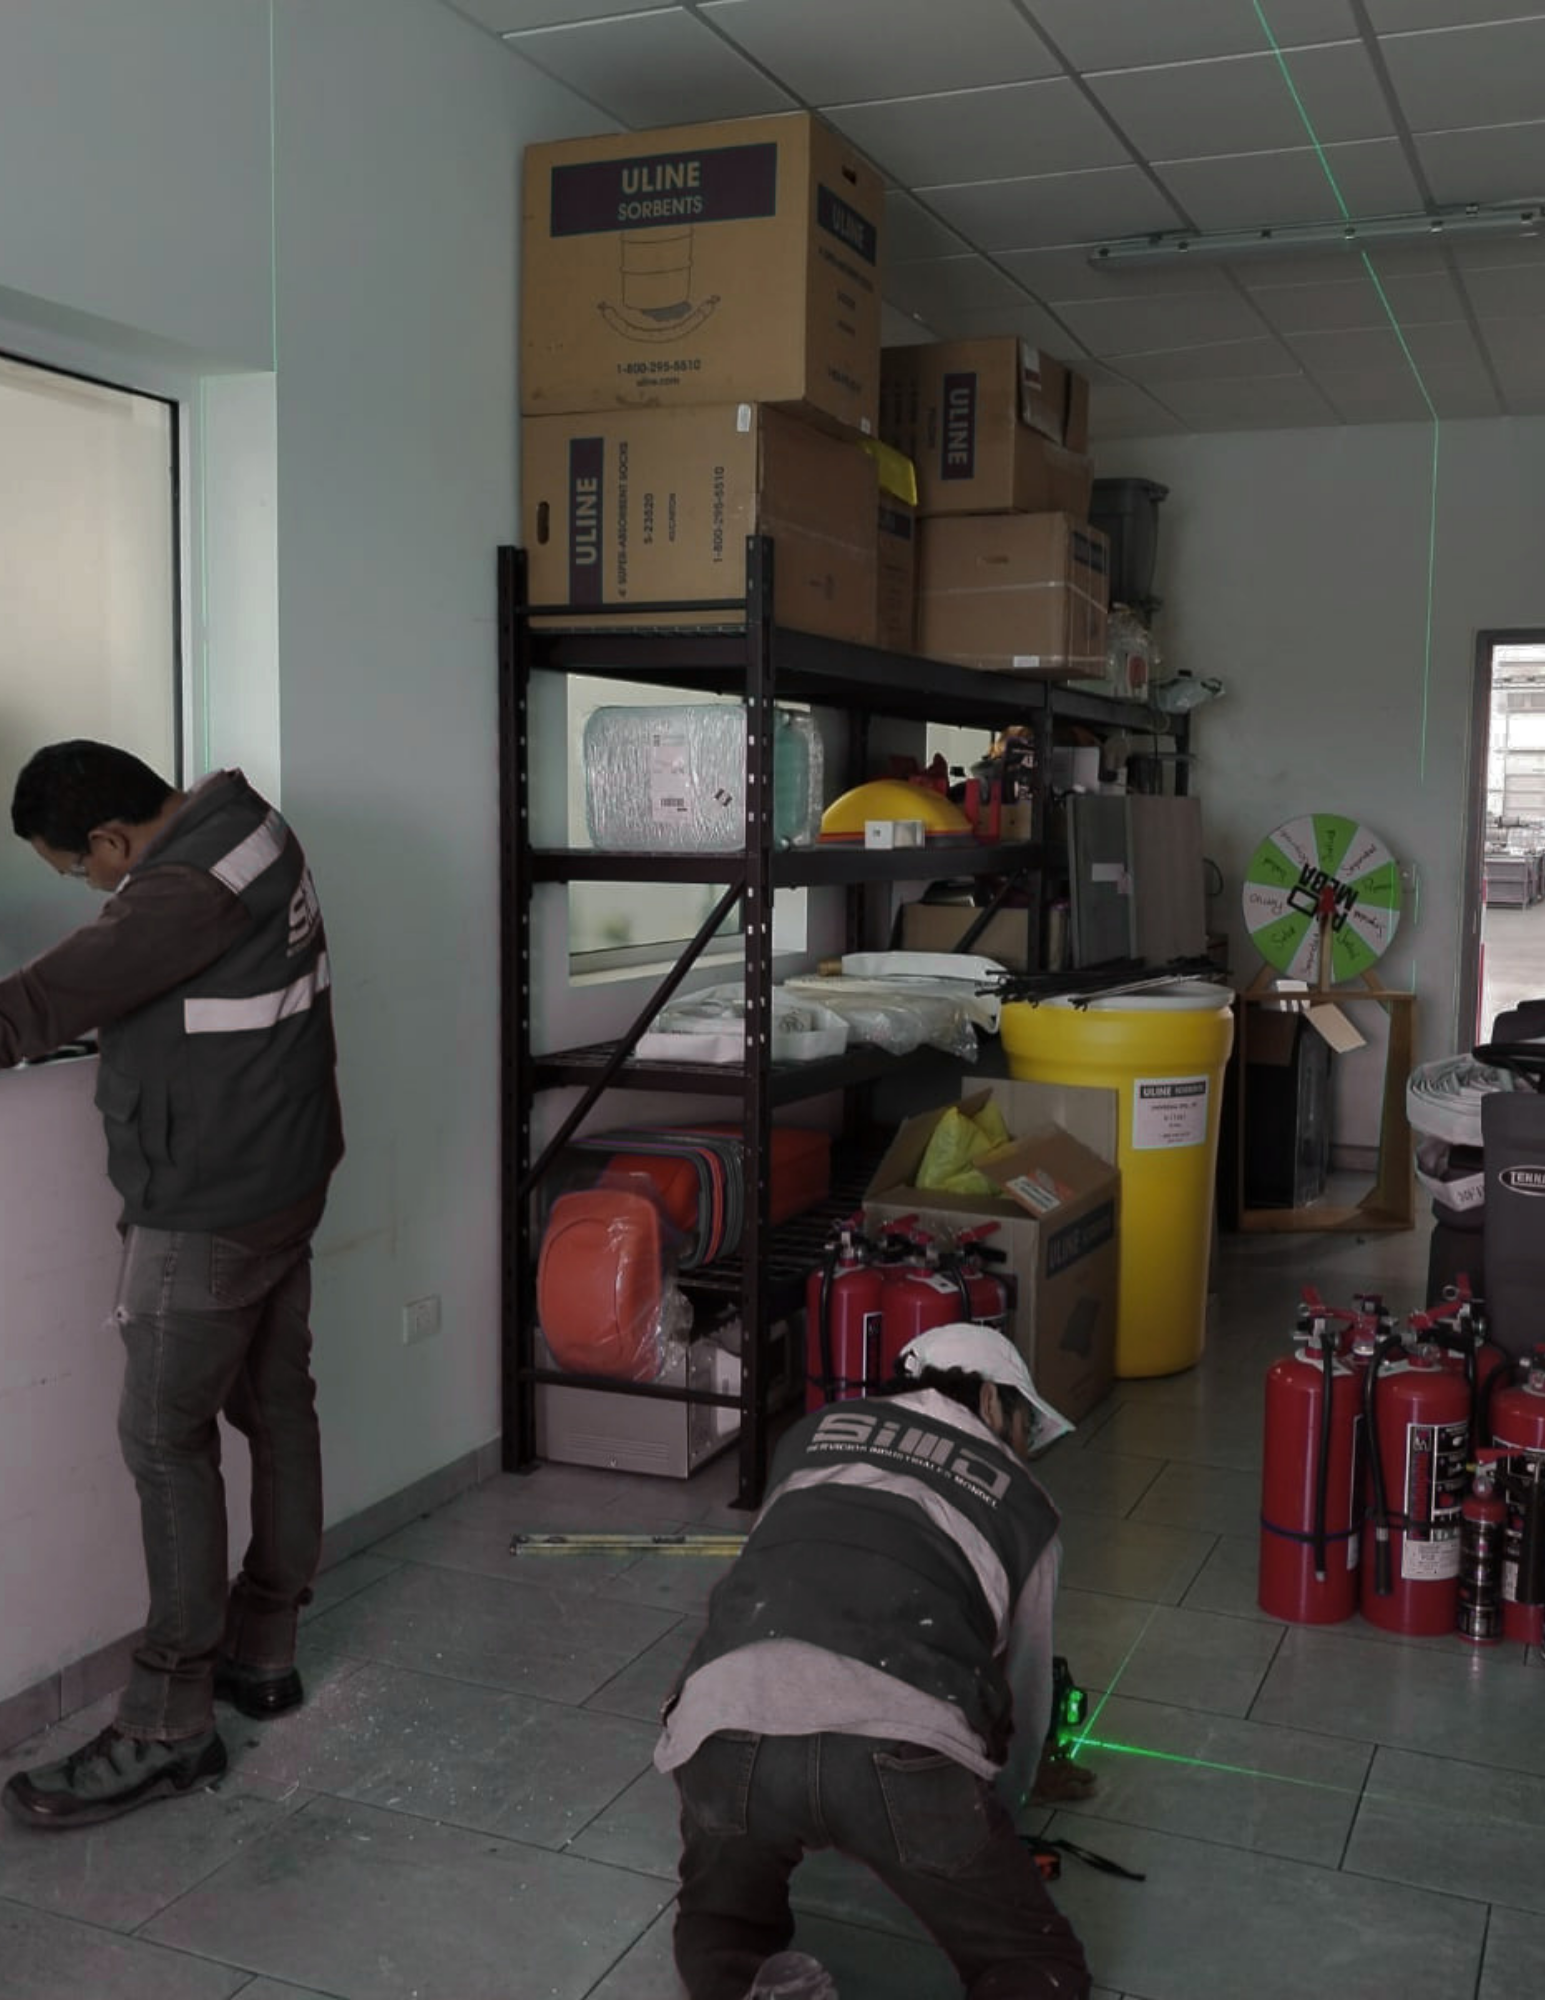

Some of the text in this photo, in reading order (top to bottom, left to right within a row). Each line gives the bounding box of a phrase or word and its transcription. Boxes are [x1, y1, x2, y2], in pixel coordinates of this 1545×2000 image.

[621, 161, 700, 194] ULINE
[617, 196, 703, 221] SORBENTS
[947, 388, 971, 465] ULINE
[575, 477, 598, 565] ULINE
[1143, 1086, 1172, 1096] ULINE
